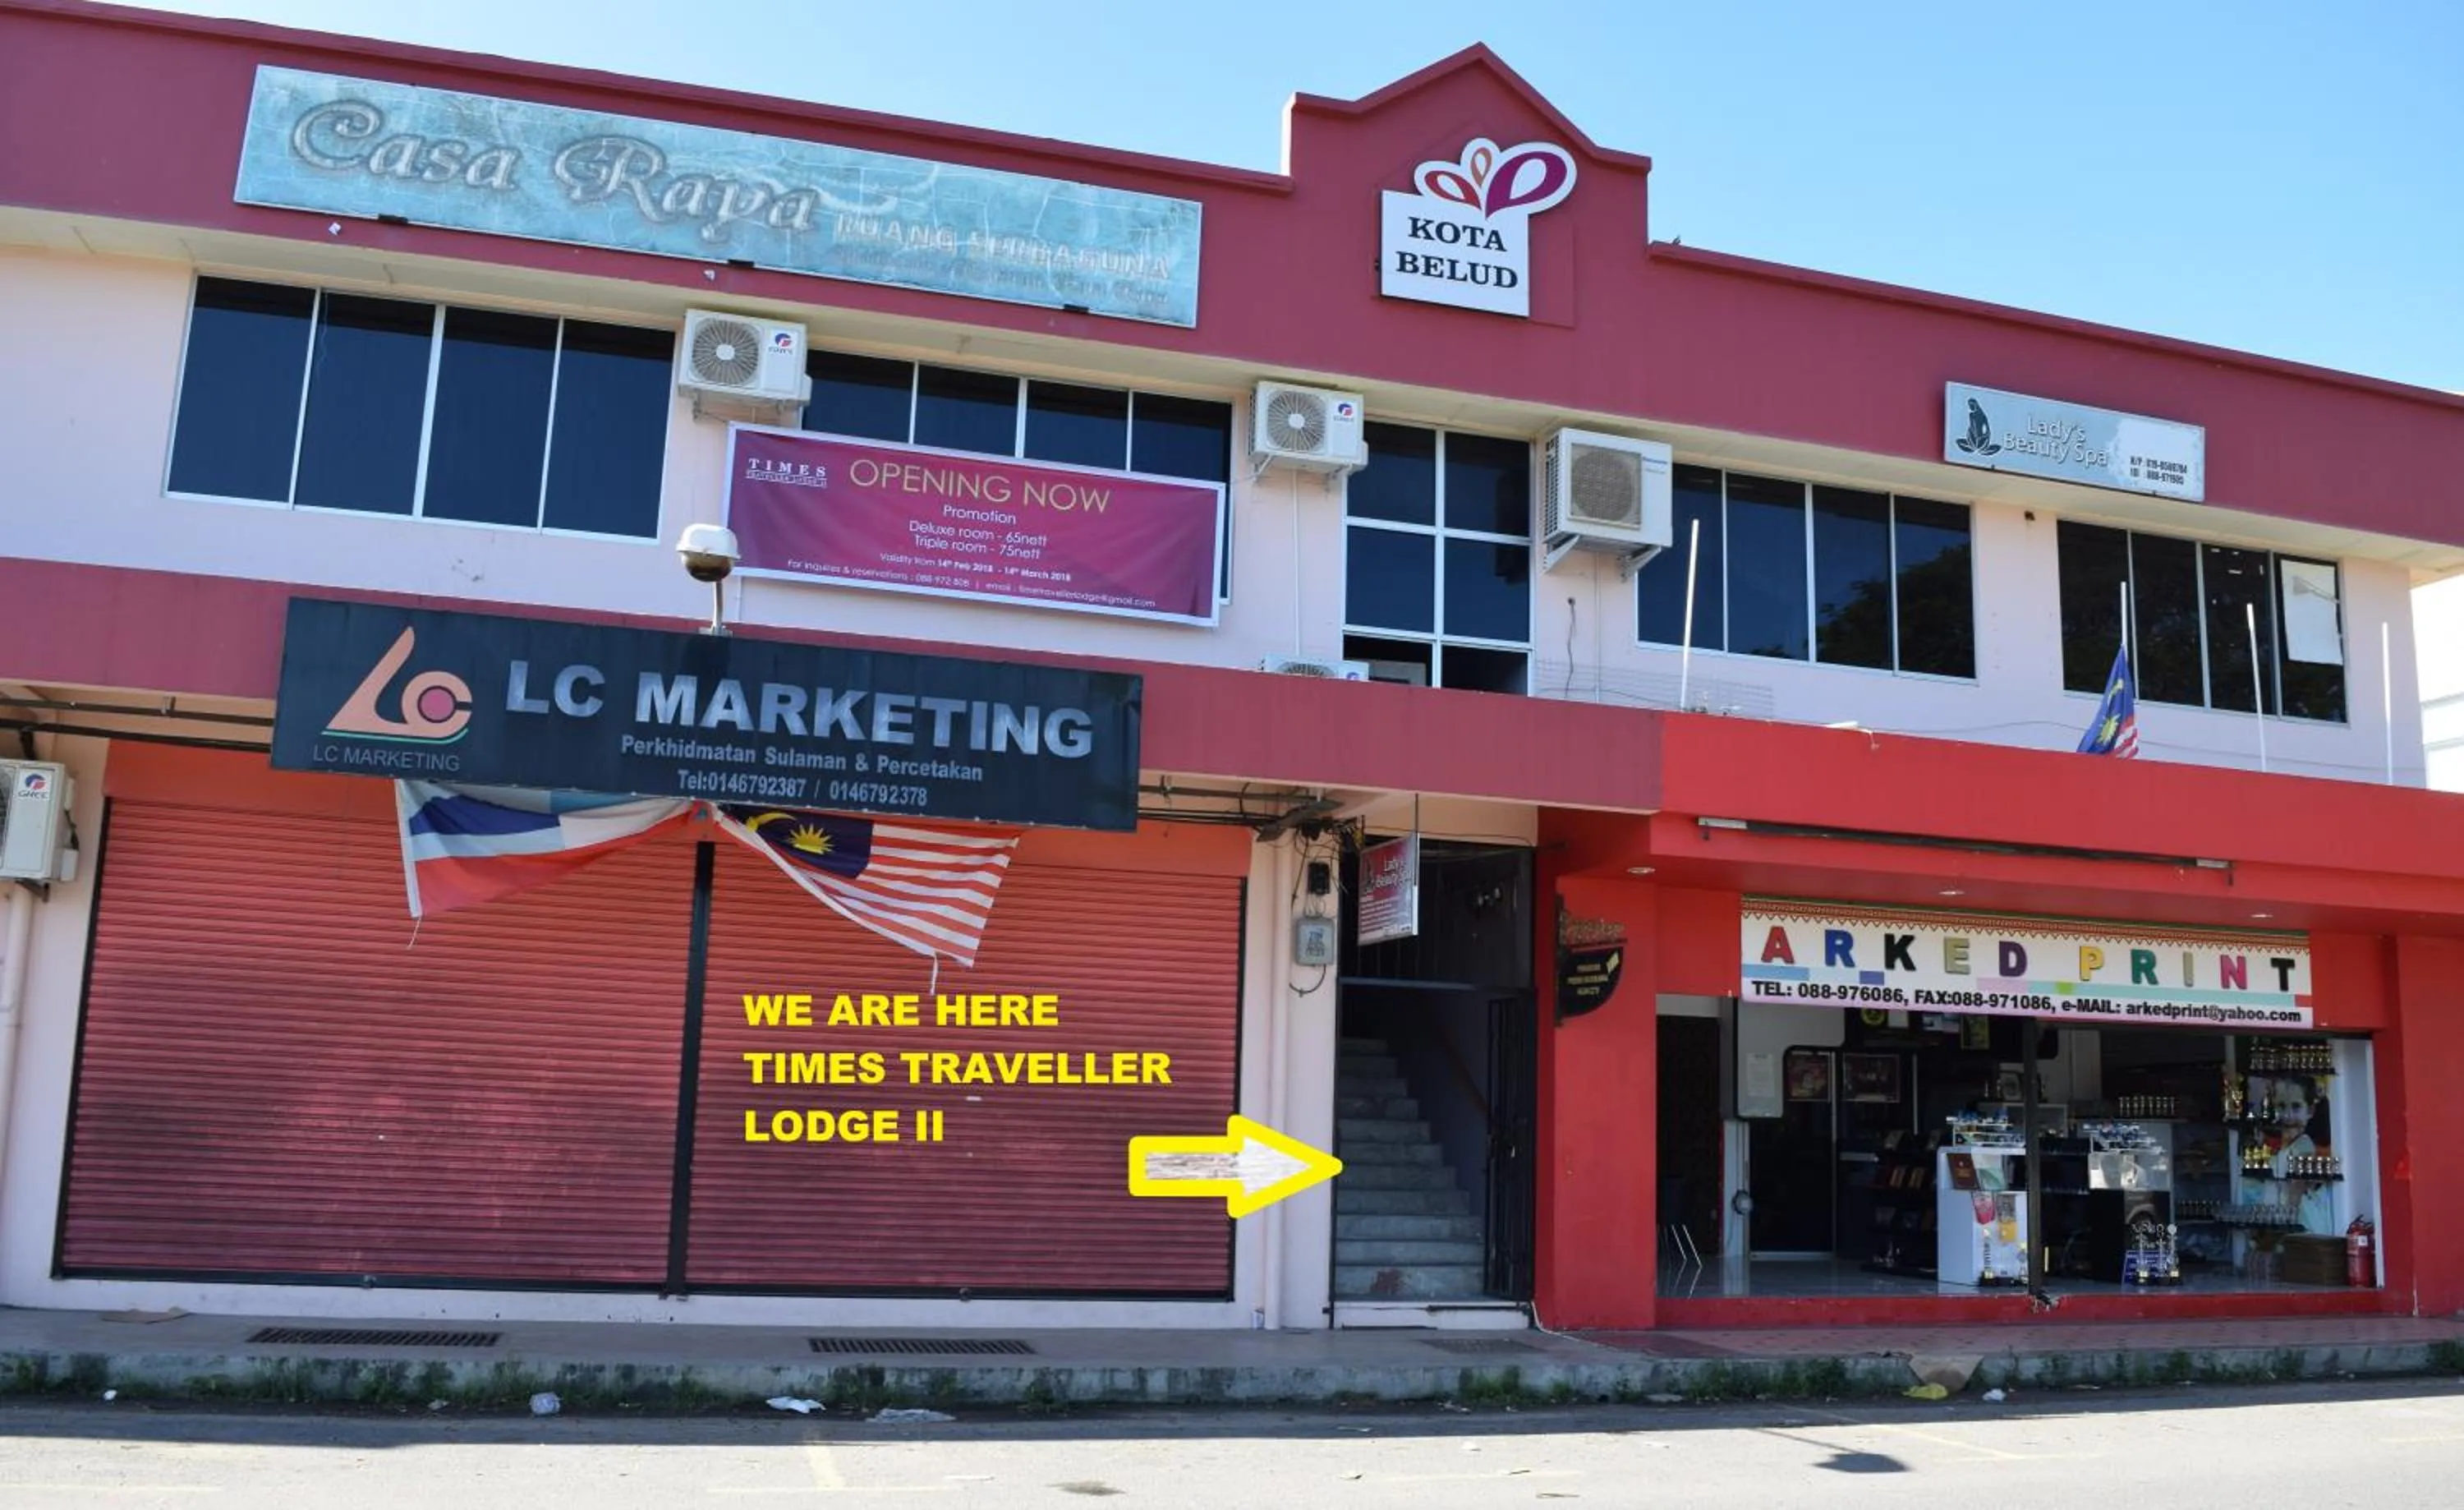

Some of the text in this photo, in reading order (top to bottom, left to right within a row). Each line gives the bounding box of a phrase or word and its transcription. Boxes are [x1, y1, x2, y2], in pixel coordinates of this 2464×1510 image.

[291, 98, 522, 191] Casa
[1408, 216, 1507, 251] KOTA
[1395, 251, 1519, 288] BELUD
[2027, 416, 2086, 444] Lady's
[748, 458, 826, 478] TIMES
[2003, 433, 2108, 467] Beauty Spa
[850, 458, 1013, 502] OPENING
[1023, 482, 1110, 513] NOW
[908, 520, 956, 536] Deluxe
[958, 527, 995, 542] room
[943, 504, 1017, 526] Promotion
[914, 534, 949, 550] Triple
[951, 541, 987, 554] room
[504, 659, 1093, 758] LC MARKETING
[312, 743, 461, 772] LC MARKETING
[621, 734, 983, 782] Perkhidmatan Sulaman & Percetakan
[677, 769, 807, 799] Tel:0146792387
[830, 780, 928, 808] 0146792378
[1760, 925, 2296, 992] ARKED PRINT
[1752, 979, 2302, 1024] TEL: 088-976086, FAX:088-971086, e-MAIL: arkedprint@yahoo.com
